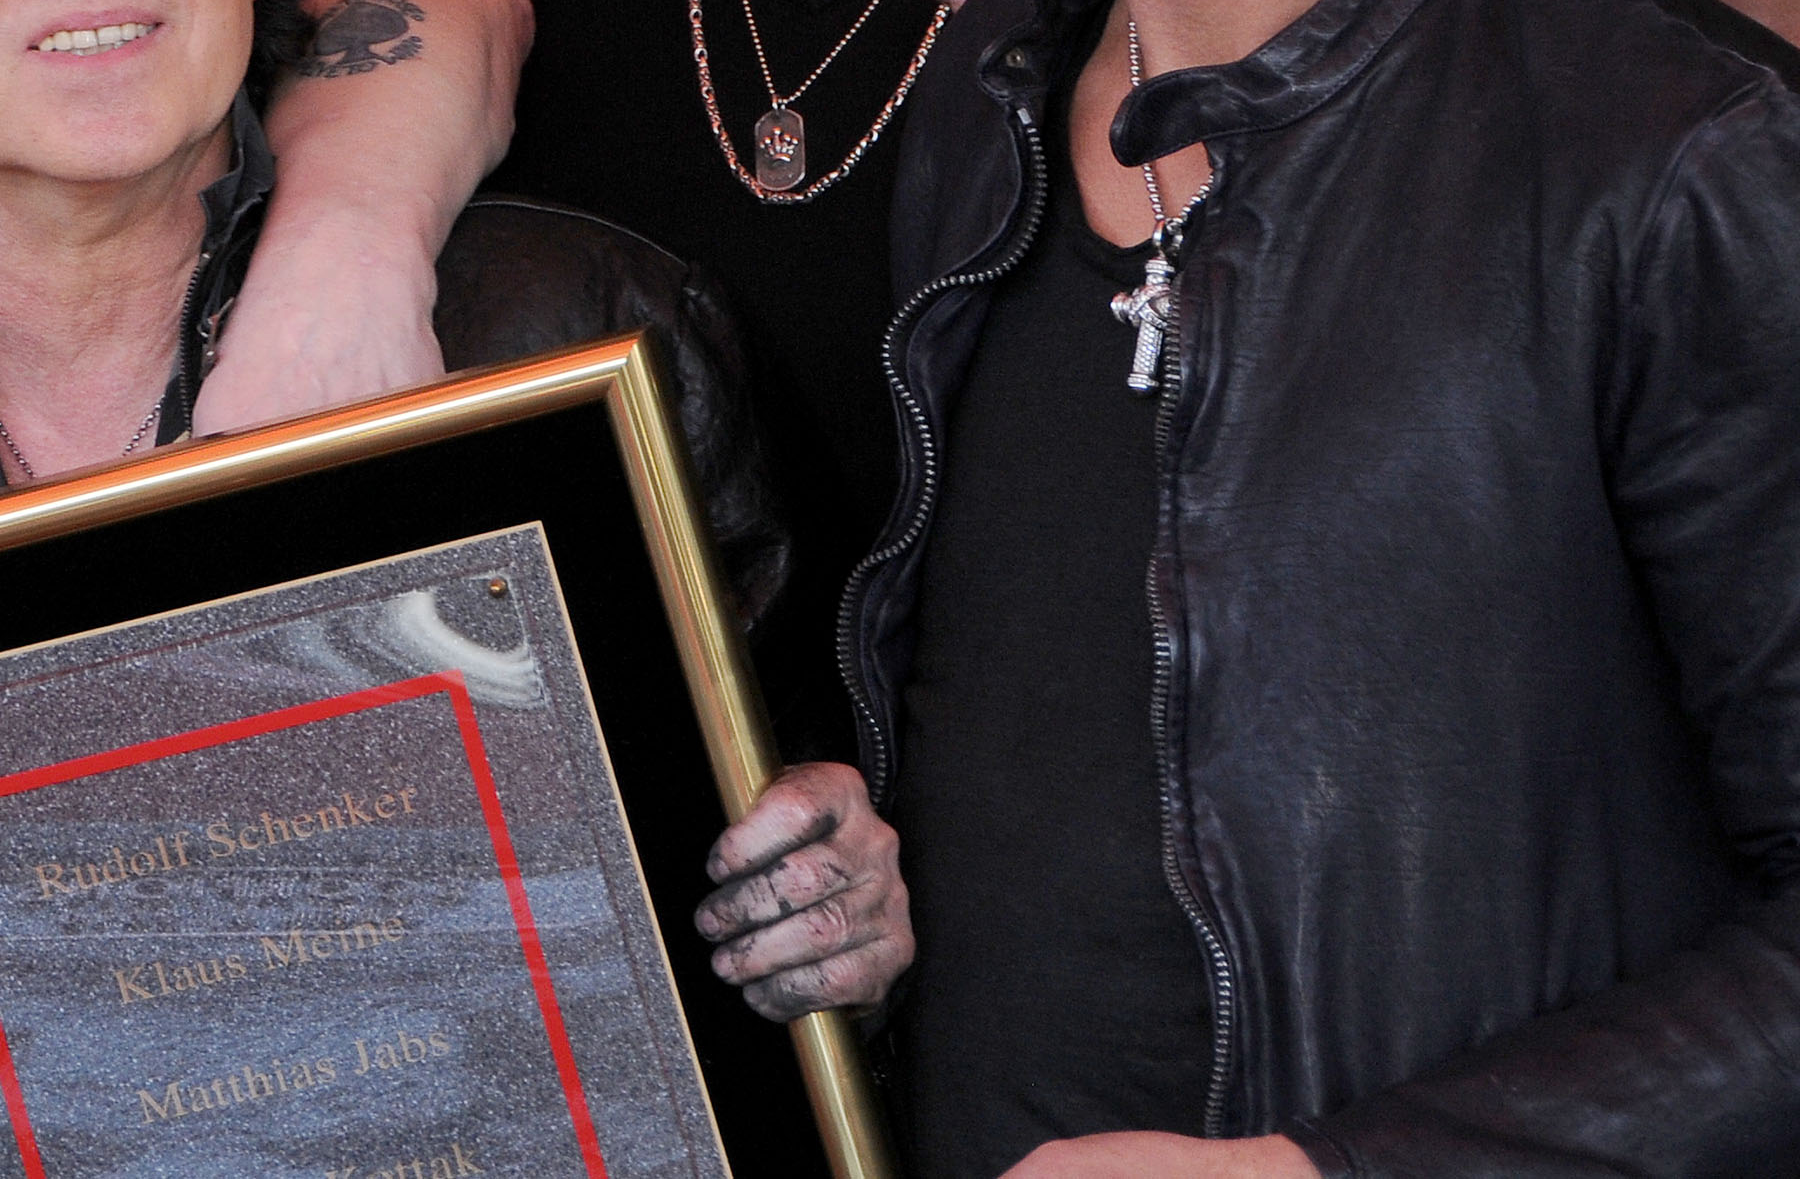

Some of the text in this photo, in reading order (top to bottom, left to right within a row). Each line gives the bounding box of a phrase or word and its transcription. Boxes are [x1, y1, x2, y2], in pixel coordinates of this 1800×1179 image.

[32, 786, 419, 898] Rudolf Schenker
[113, 916, 405, 1005] Klaus Meine
[137, 1027, 453, 1124] Matthias Jabs
